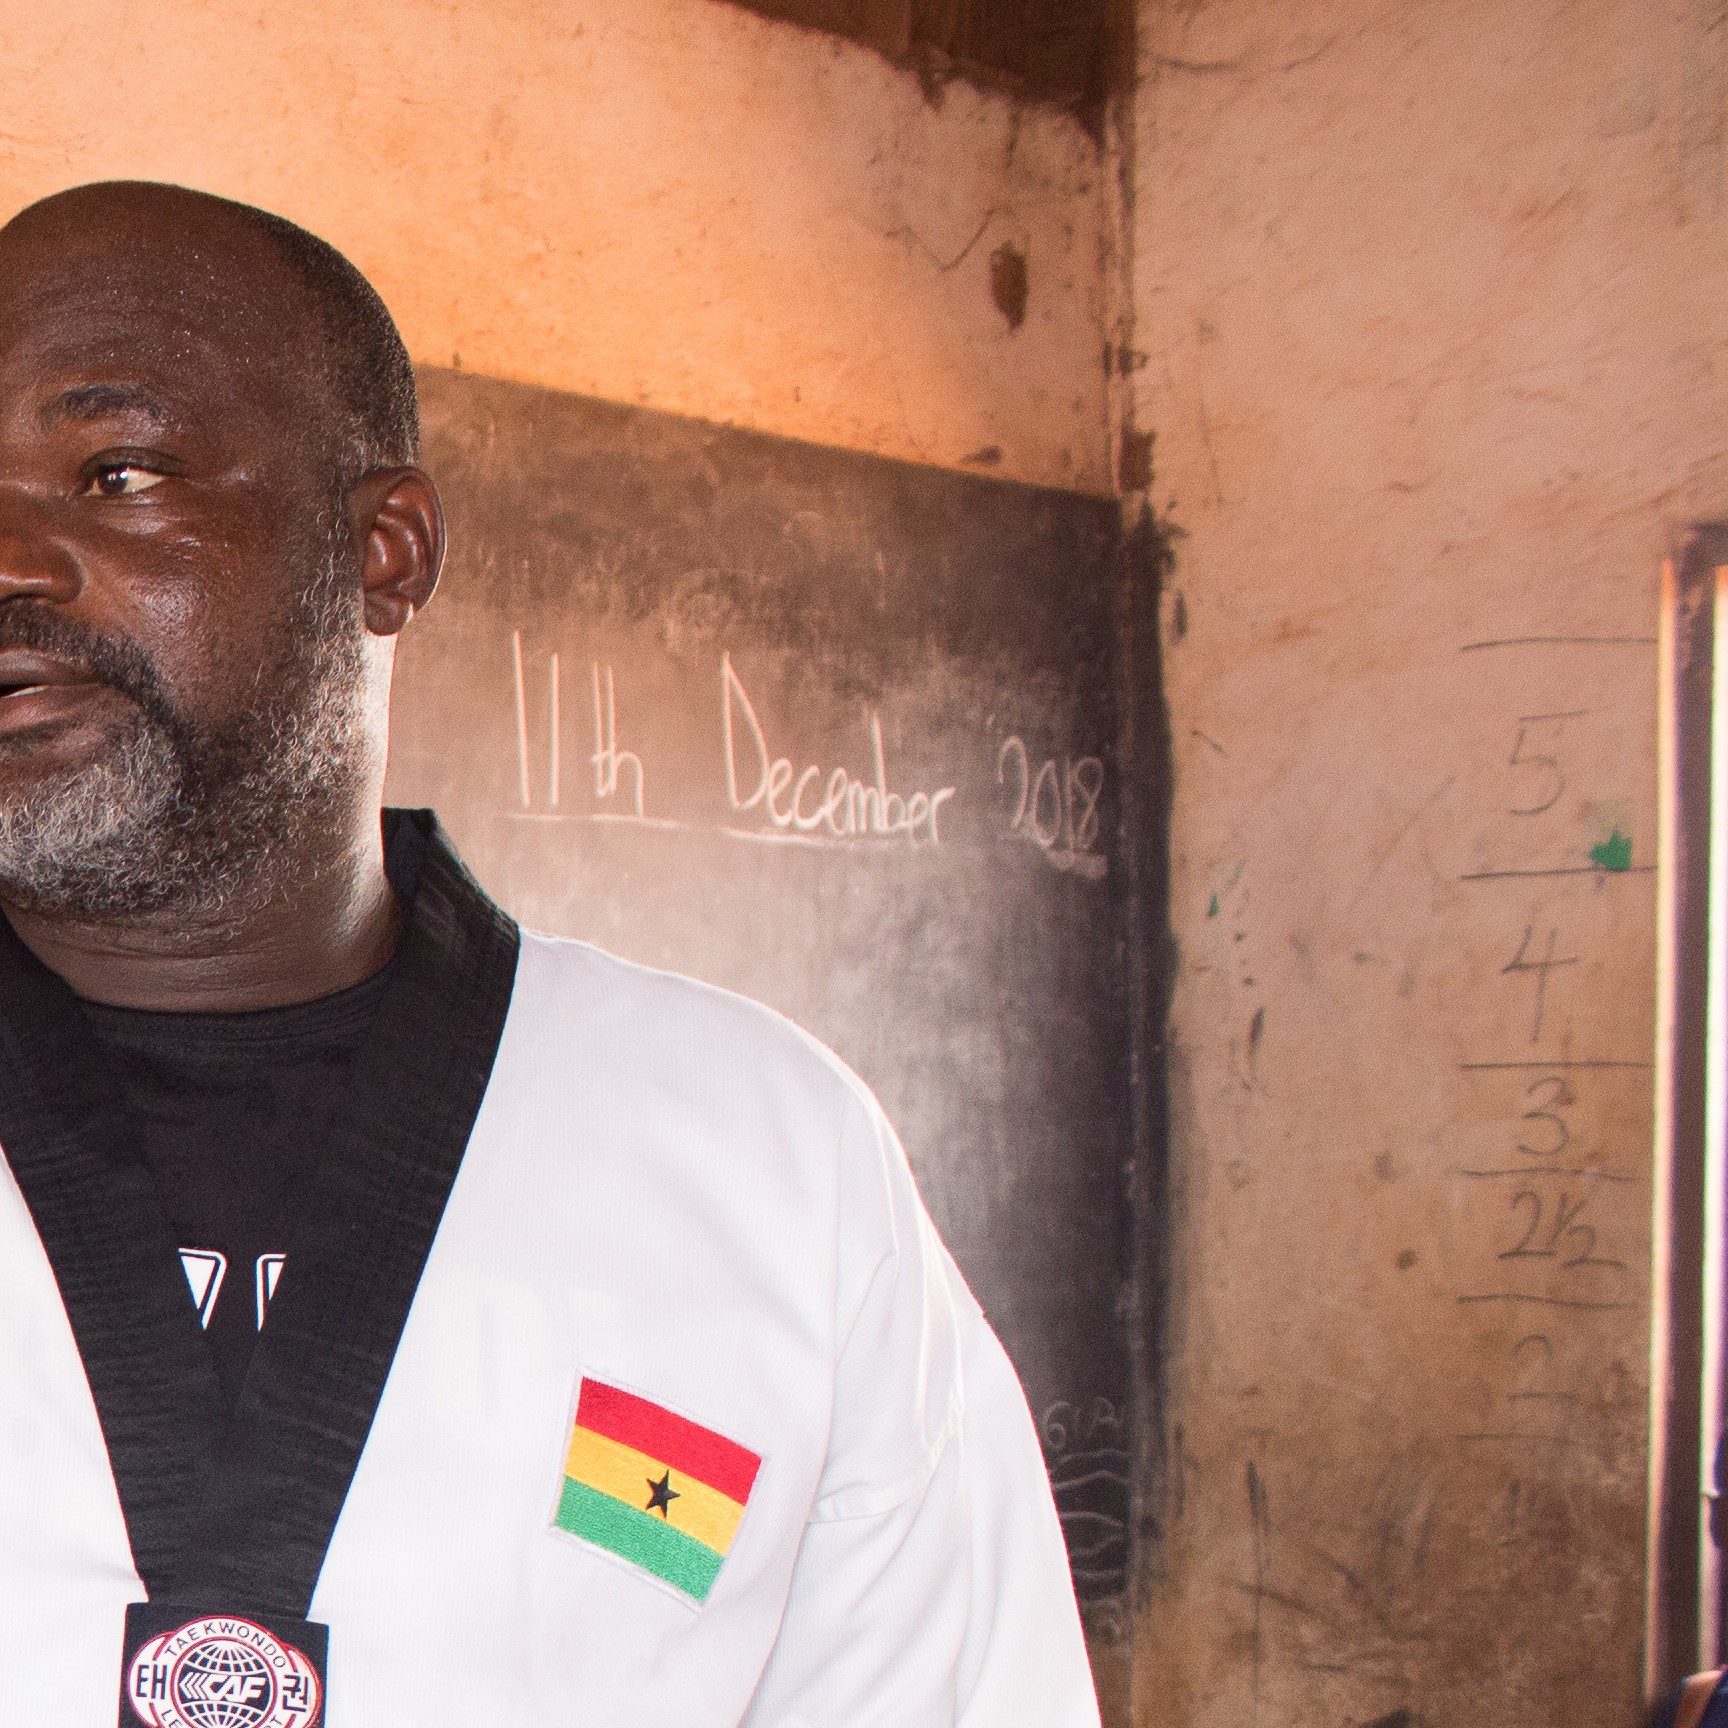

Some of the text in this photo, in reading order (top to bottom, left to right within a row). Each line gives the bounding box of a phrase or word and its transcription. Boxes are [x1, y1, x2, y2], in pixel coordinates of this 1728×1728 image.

[722, 650, 957, 848] December
[996, 734, 1106, 853] 2018
[1507, 708, 1590, 817] 5
[1500, 923, 1581, 1045] 4
[1516, 1074, 1572, 1158] 3
[164, 1620, 287, 1669] TAEKWONDO
